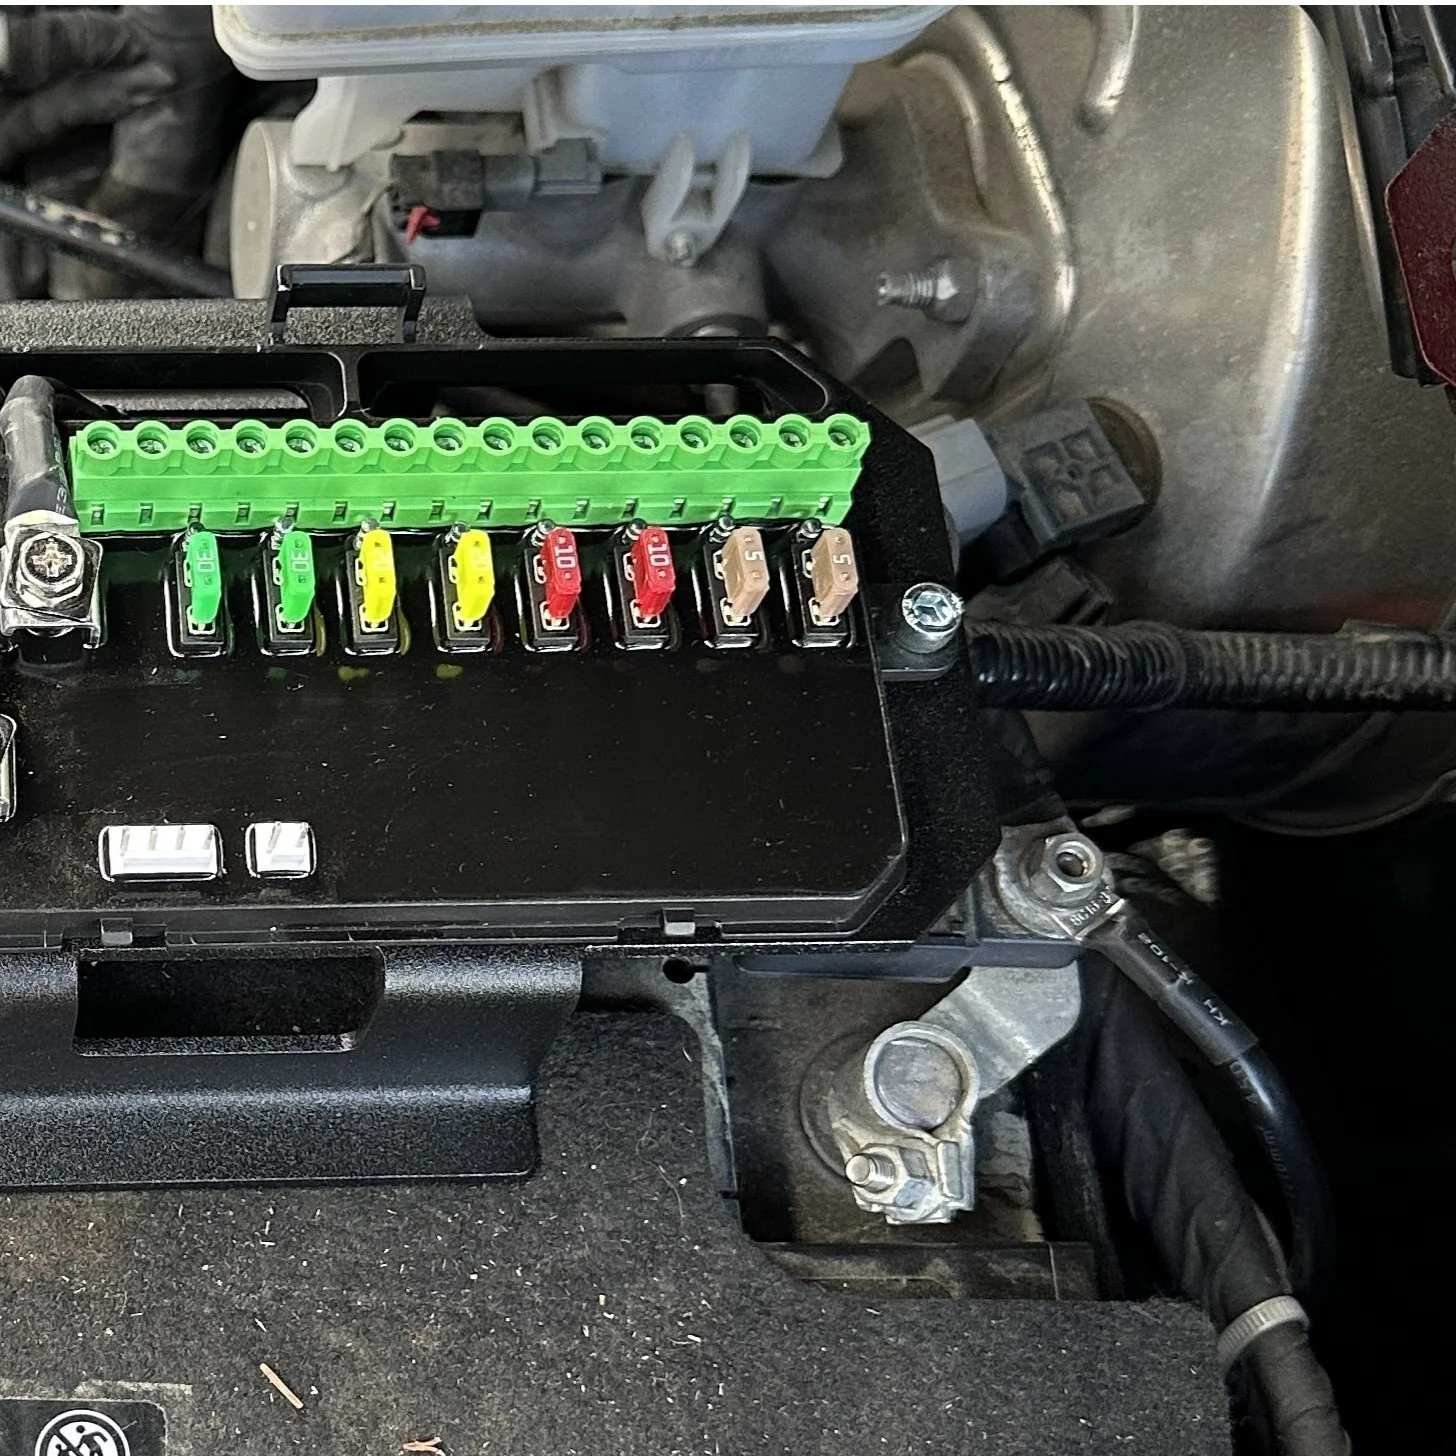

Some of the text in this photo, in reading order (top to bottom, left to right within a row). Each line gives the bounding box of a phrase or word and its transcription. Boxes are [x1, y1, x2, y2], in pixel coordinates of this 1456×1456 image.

[196, 550, 216, 573] 30
[291, 550, 311, 573] 30
[553, 544, 576, 570] 10
[646, 543, 671, 568] 10
[743, 549, 764, 562] 5
[832, 553, 852, 566] 5
